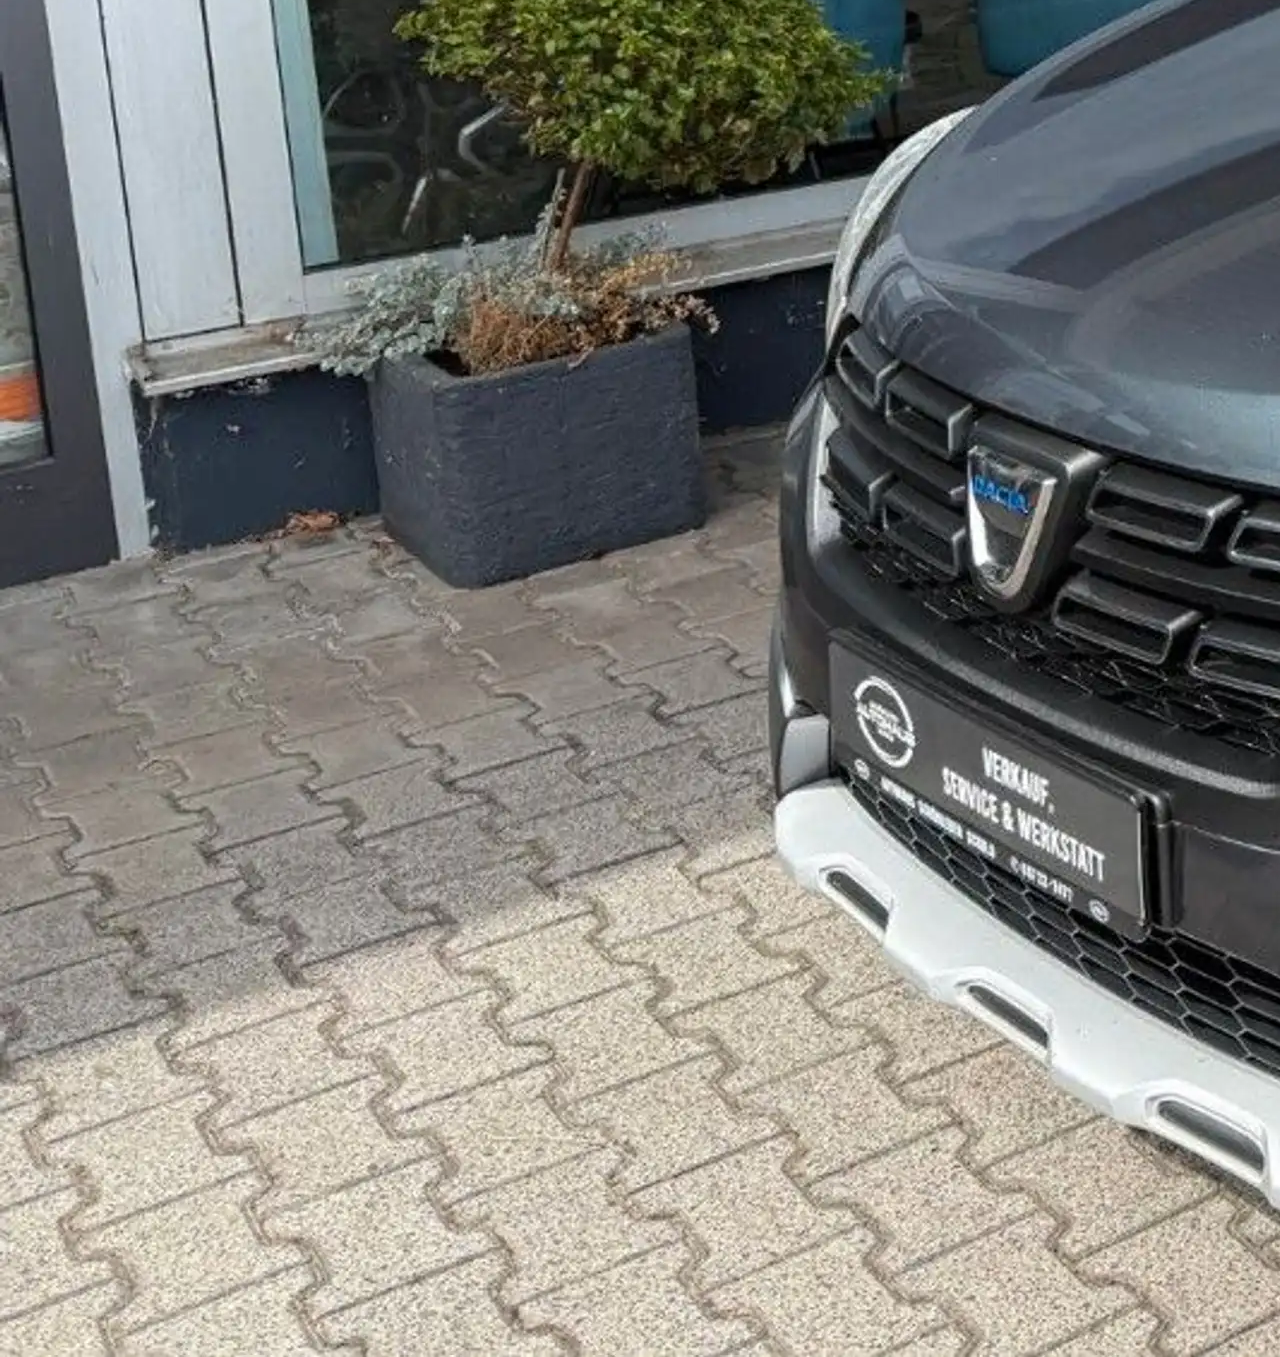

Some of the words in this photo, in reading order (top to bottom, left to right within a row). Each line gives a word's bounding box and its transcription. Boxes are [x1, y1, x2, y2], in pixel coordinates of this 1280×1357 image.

[941, 766, 999, 823] SERVICE
[1002, 800, 1015, 832] &
[1017, 807, 1106, 883] WERKSTATT
